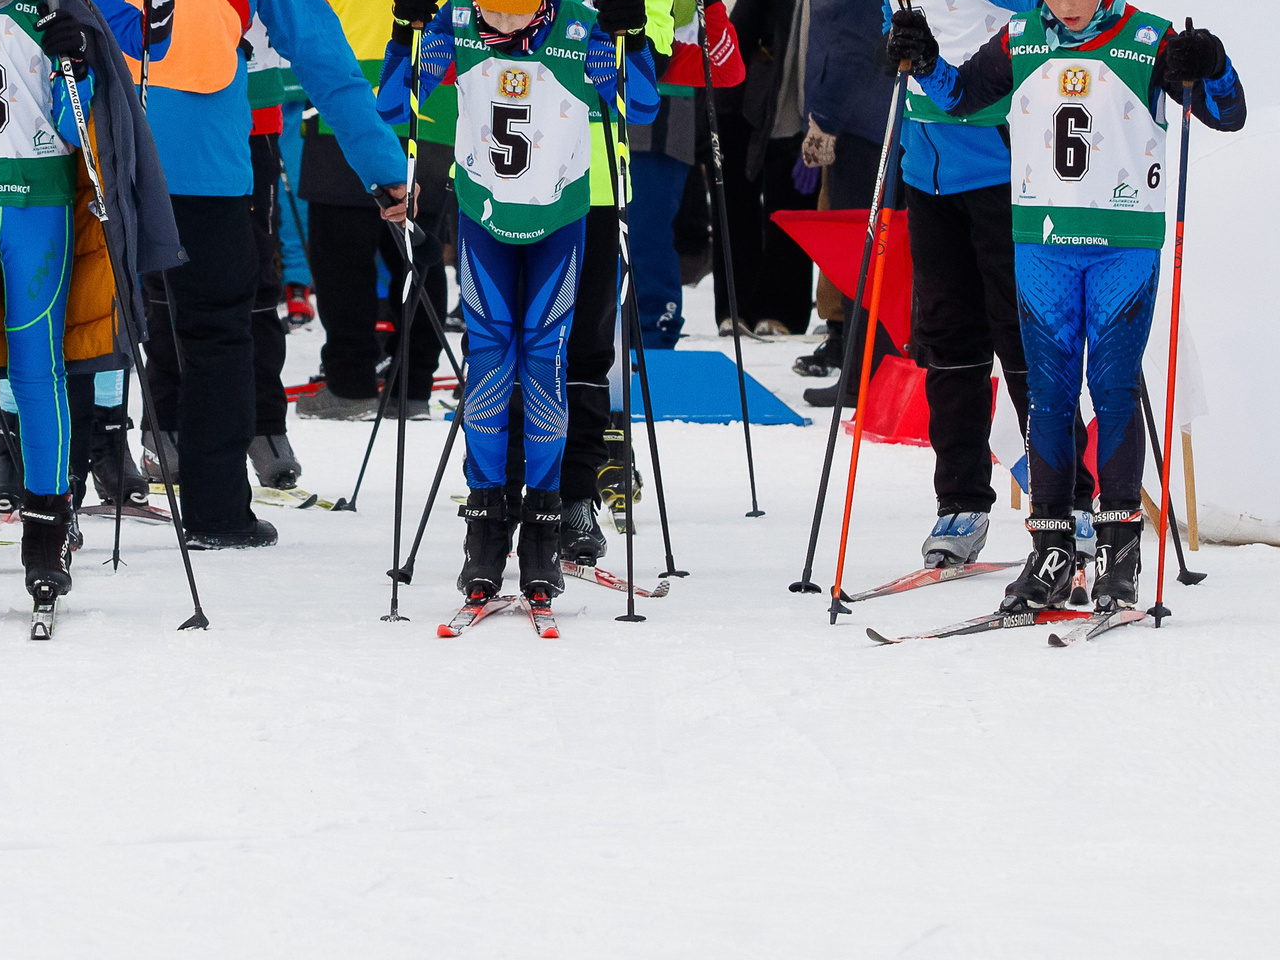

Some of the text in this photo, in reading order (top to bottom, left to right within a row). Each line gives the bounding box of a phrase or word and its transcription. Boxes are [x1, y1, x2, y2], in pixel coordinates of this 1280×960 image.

[455, 37, 492, 52] МСКАЯ
[1010, 44, 1050, 57] МСКАЯ
[67, 79, 95, 125] NORDWAY
[488, 101, 532, 179] 5
[1052, 102, 1093, 182] 6
[1146, 162, 1161, 189] 6
[1051, 233, 1109, 247] Ростелеком
[464, 508, 488, 517] TISA
[535, 513, 561, 521] TISA
[1093, 510, 1130, 522] OSSIGNOL
[1027, 519, 1072, 530] ROSSIGNOL
[1003, 612, 1035, 628] ROSSIGNOL
